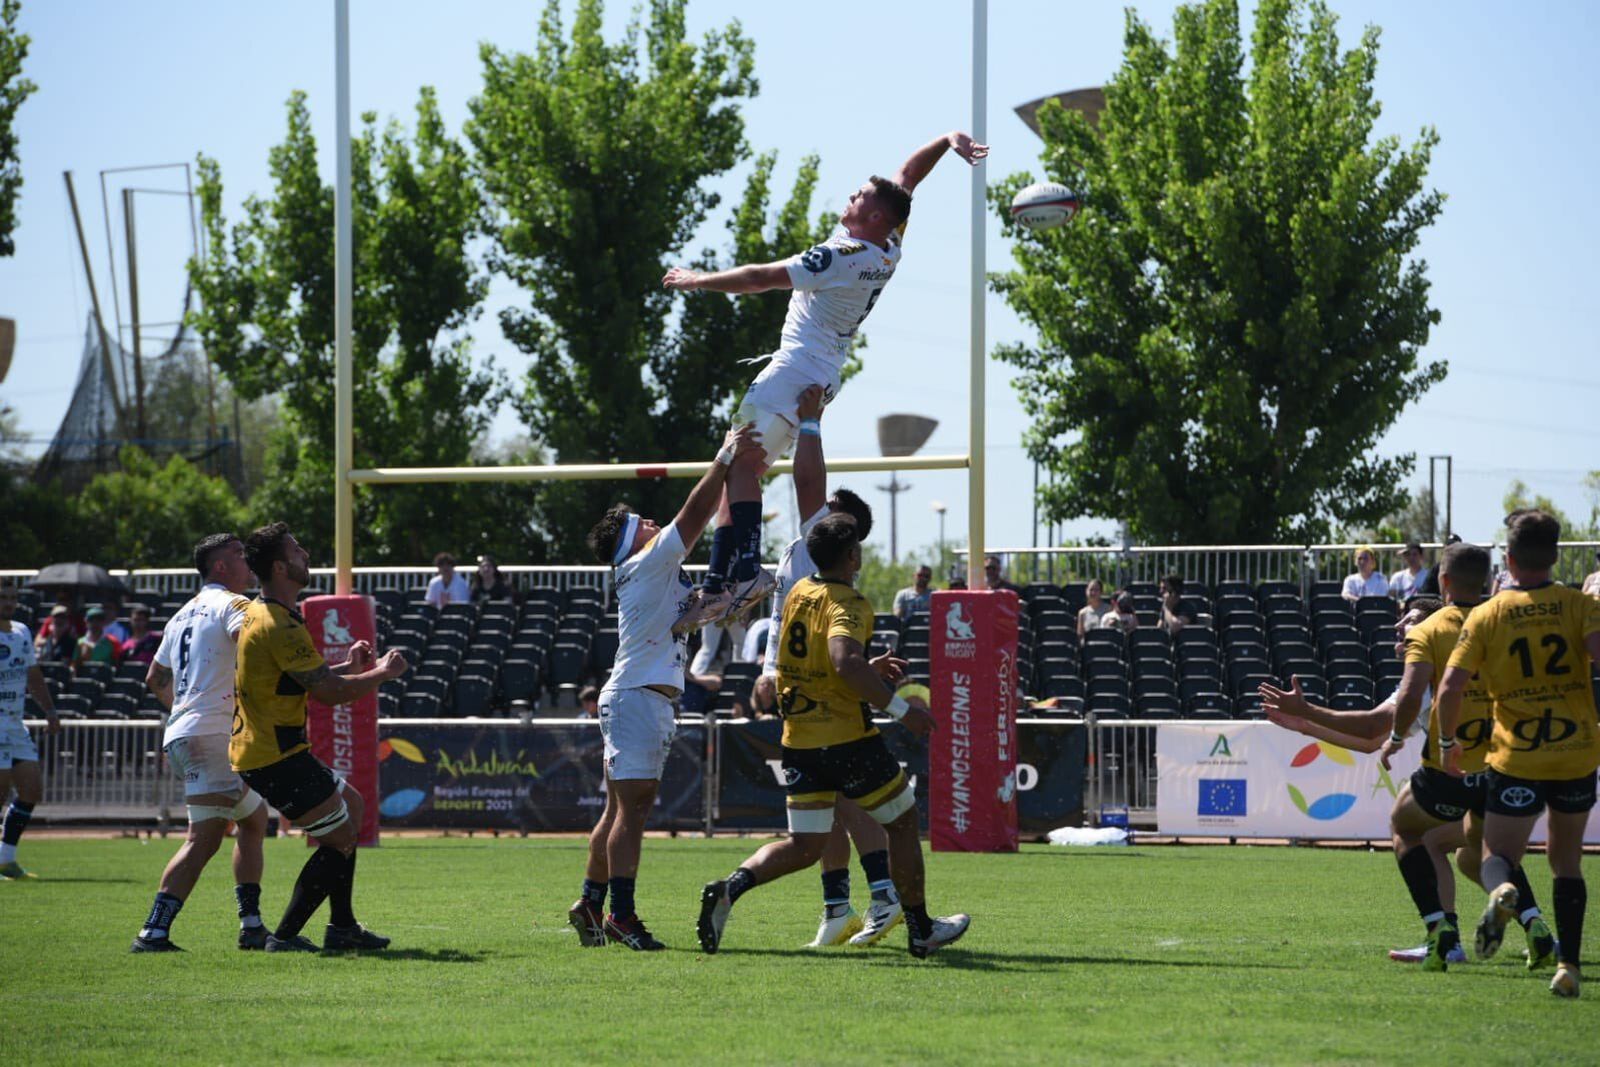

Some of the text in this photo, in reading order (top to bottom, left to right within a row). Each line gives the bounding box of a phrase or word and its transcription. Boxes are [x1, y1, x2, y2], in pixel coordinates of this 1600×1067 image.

[1508, 601, 1563, 620] itesal
[179, 627, 194, 671] 6
[788, 621, 808, 659] 8
[1509, 633, 1571, 678] 12
[950, 671, 971, 834] #VAMOSLEONAS
[434, 799, 512, 811] DEPORTE 2021
